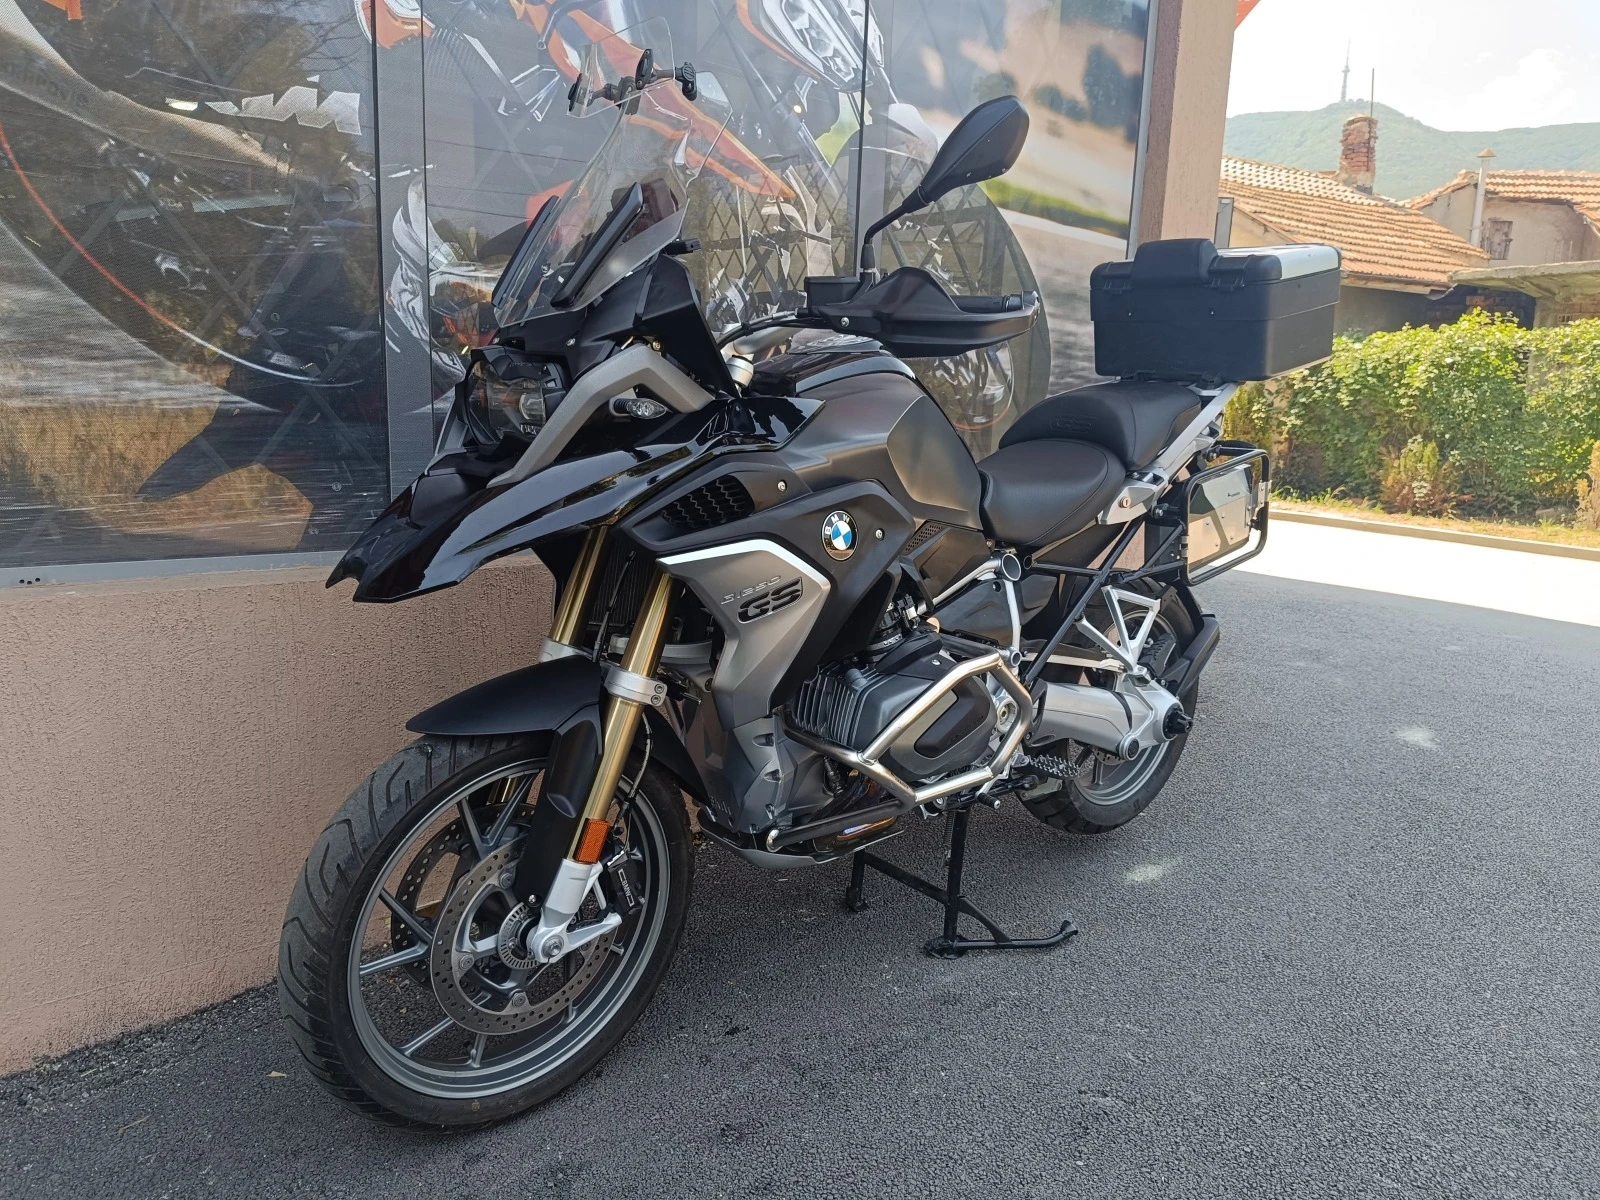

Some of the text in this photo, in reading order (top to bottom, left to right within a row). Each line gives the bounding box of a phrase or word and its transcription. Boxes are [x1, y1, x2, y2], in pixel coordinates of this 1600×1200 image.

[824, 513, 851, 535] BMW
[738, 576, 803, 623] GS
[622, 879, 632, 897] BMW
